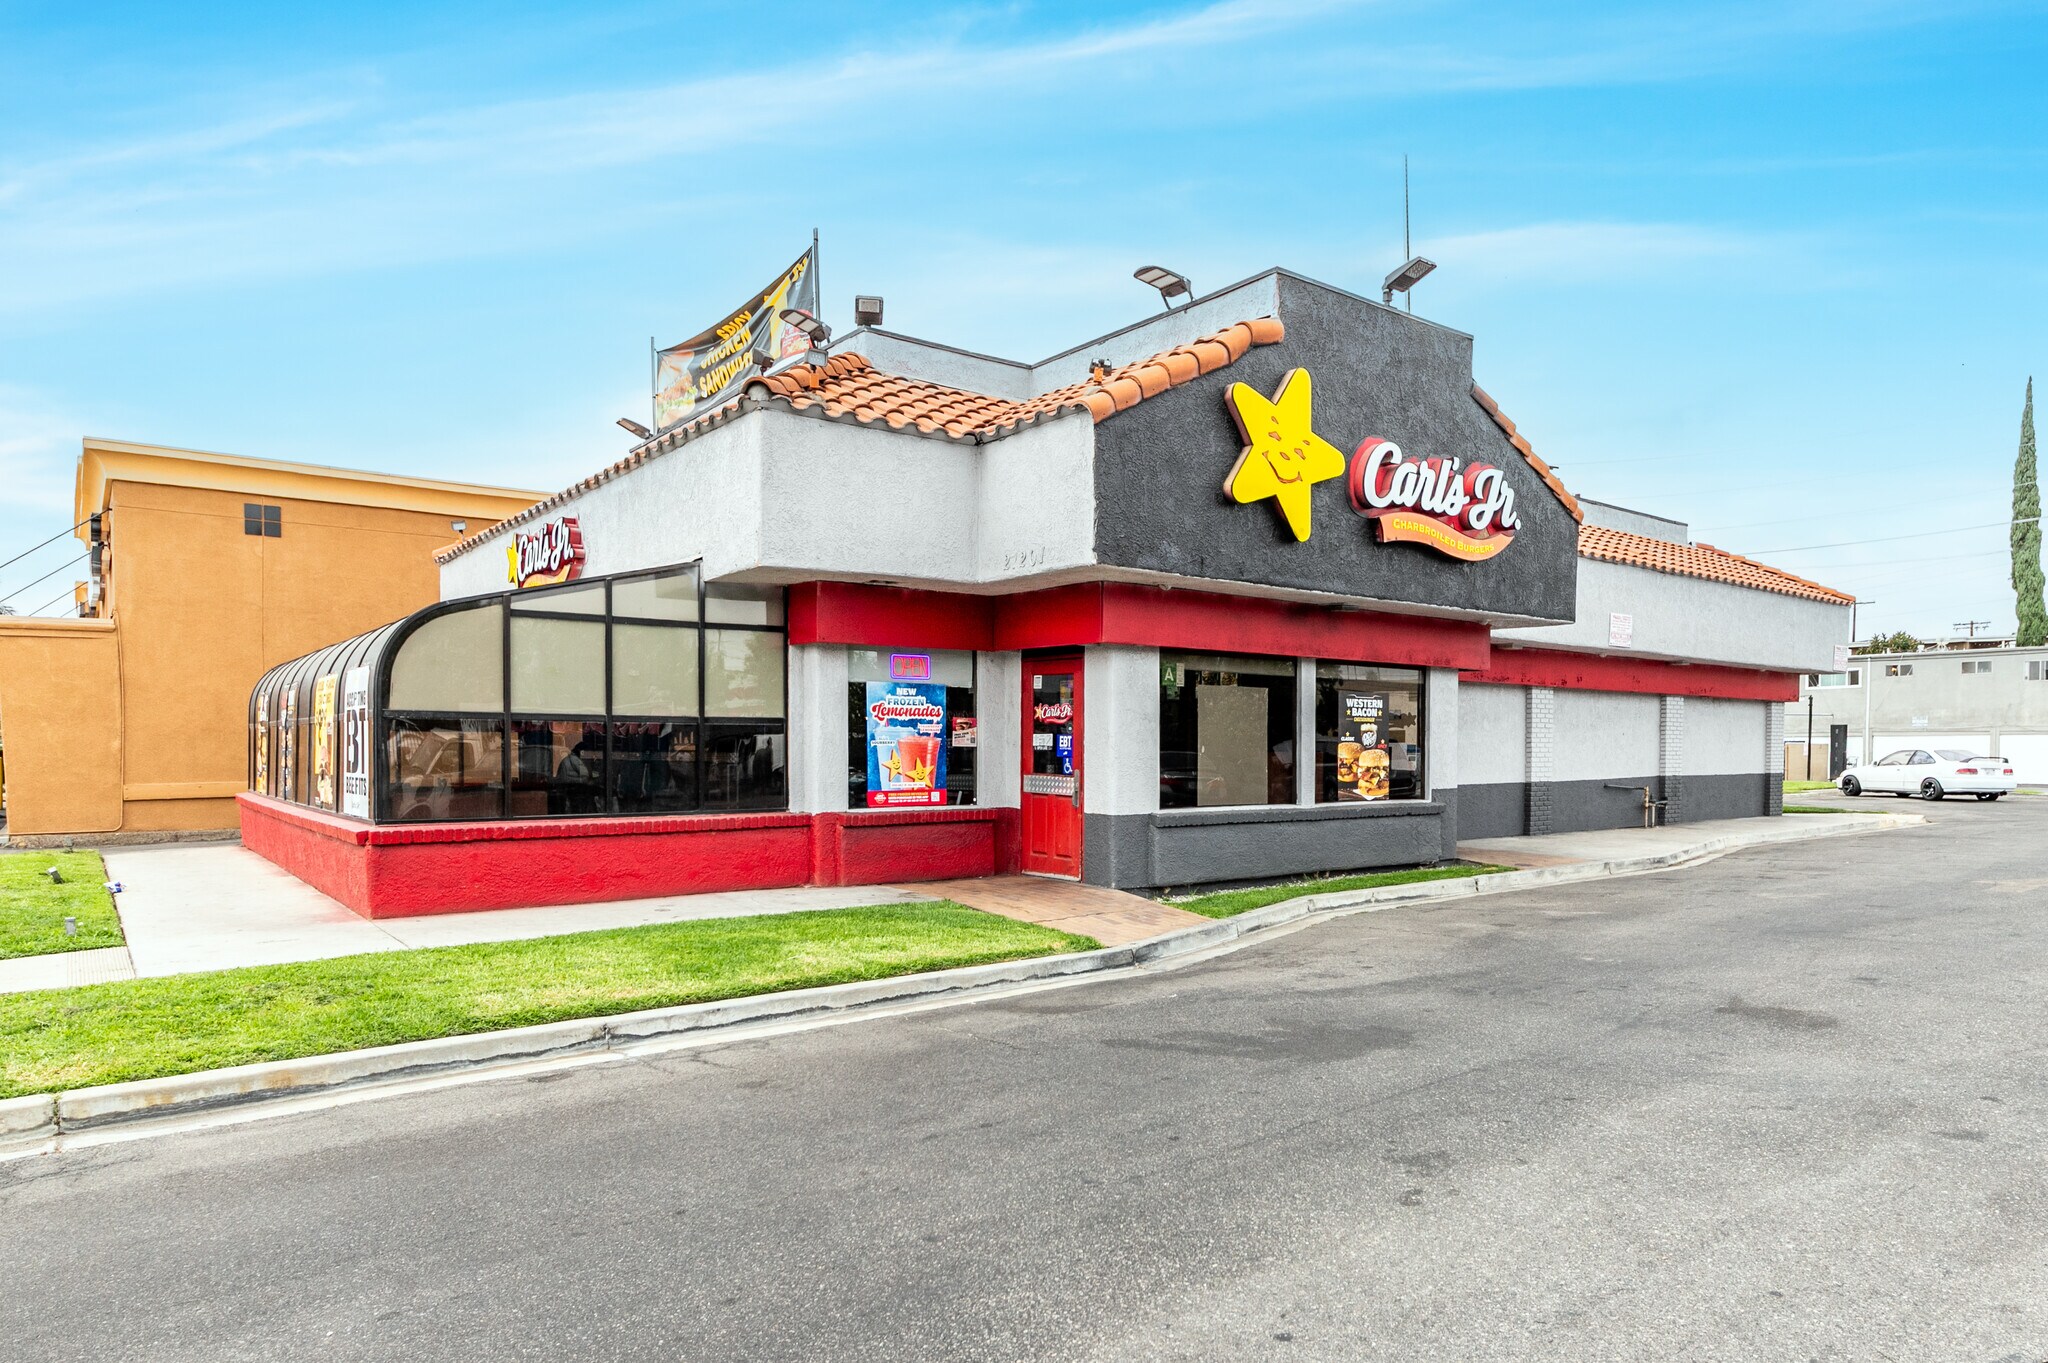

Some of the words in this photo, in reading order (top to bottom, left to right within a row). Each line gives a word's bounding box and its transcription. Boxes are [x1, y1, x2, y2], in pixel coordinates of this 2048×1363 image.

[1363, 441, 1470, 516] Carl's
[1468, 468, 1521, 530] Jr.
[1393, 518, 1456, 547] CHARBROILED
[1457, 540, 1495, 553] BURGERS
[518, 523, 551, 581] Carl's
[550, 517, 575, 571] Jr.
[893, 656, 929, 676] OPEN
[1164, 667, 1175, 681] A
[896, 687, 917, 696] NEW
[887, 697, 925, 706] FROZEN
[1346, 698, 1383, 709] WESTERN
[871, 702, 942, 721] Lemonades
[1352, 708, 1378, 717] BACON
[1059, 735, 1072, 748] EBT
